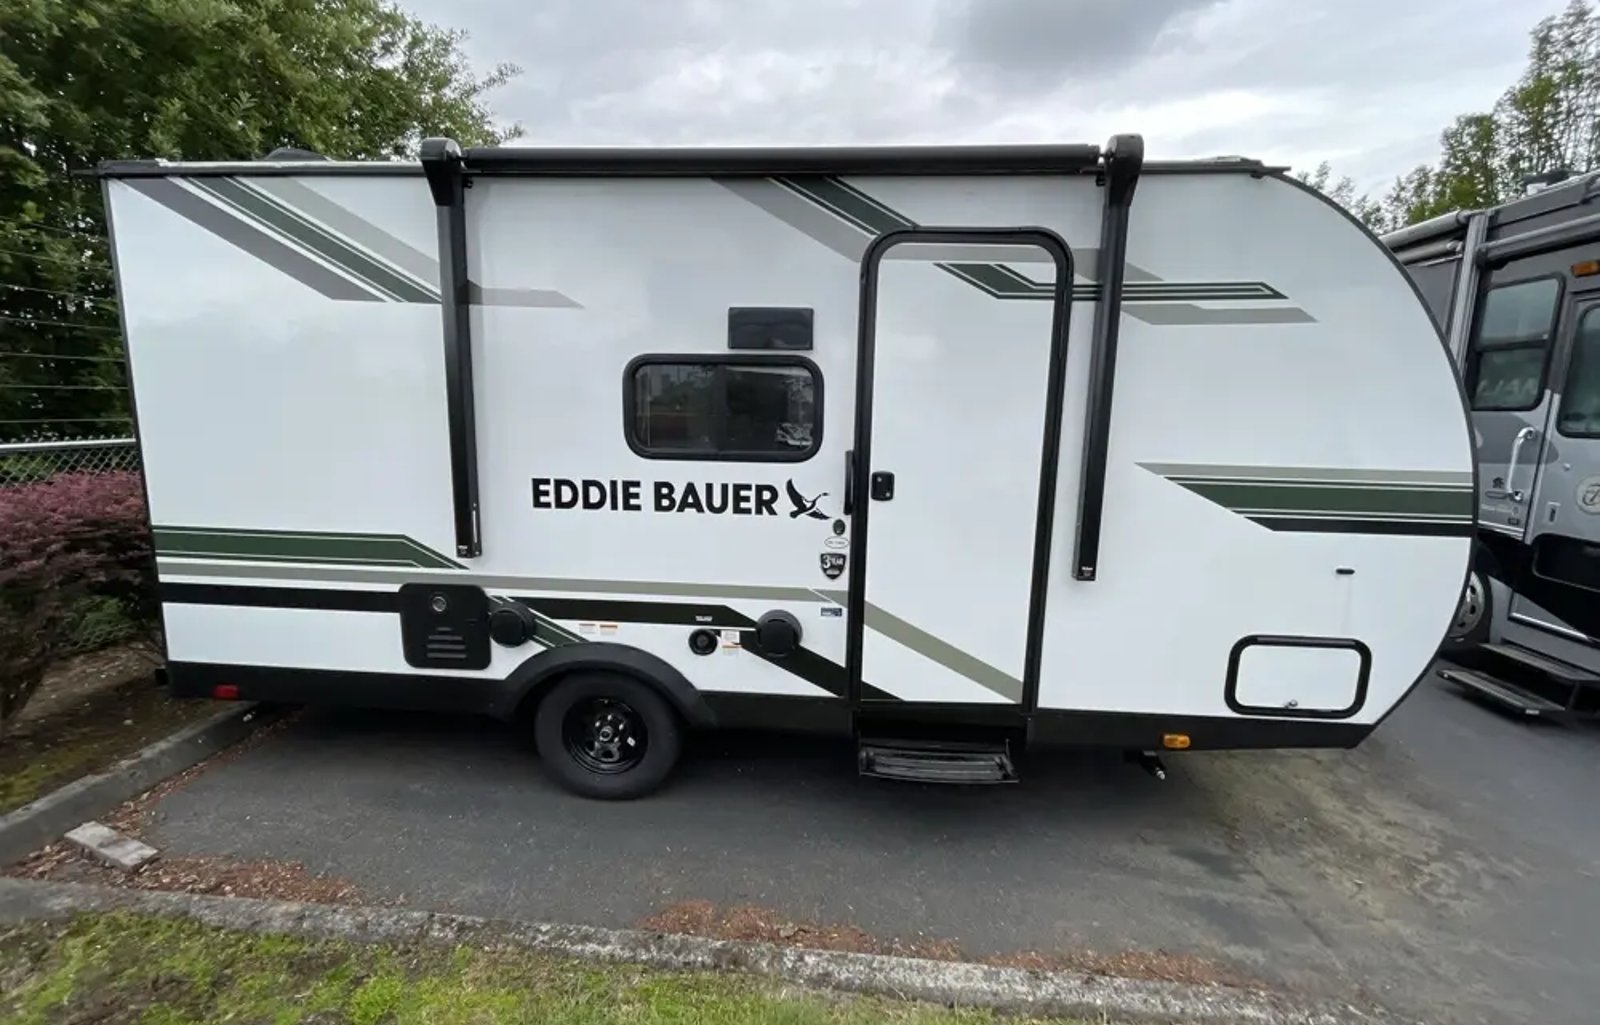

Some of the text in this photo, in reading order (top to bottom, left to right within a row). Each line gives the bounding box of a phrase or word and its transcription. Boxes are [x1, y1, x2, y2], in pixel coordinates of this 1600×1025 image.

[531, 477, 779, 516] EDDIE BAUER
[823, 555, 831, 569] 3
